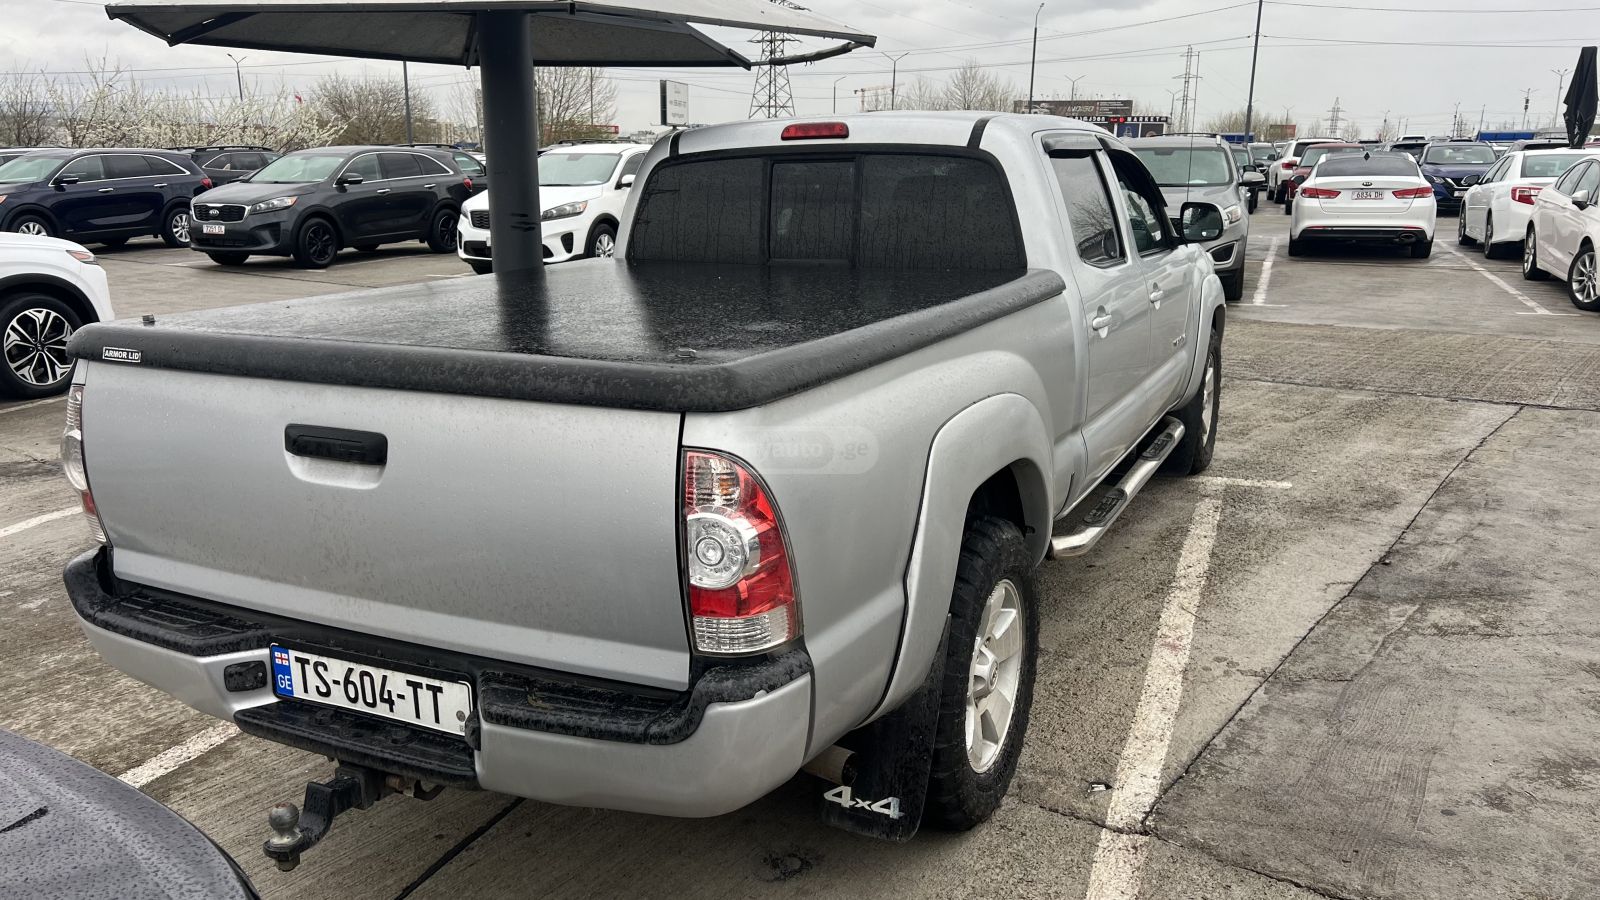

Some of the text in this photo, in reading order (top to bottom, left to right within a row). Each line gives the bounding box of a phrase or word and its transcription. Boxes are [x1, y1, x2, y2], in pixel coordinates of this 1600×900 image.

[105, 350, 127, 358] ARMOR
[277, 674, 292, 690] GE
[294, 655, 444, 725] TS-604-TT
[823, 785, 905, 820] 4x4
